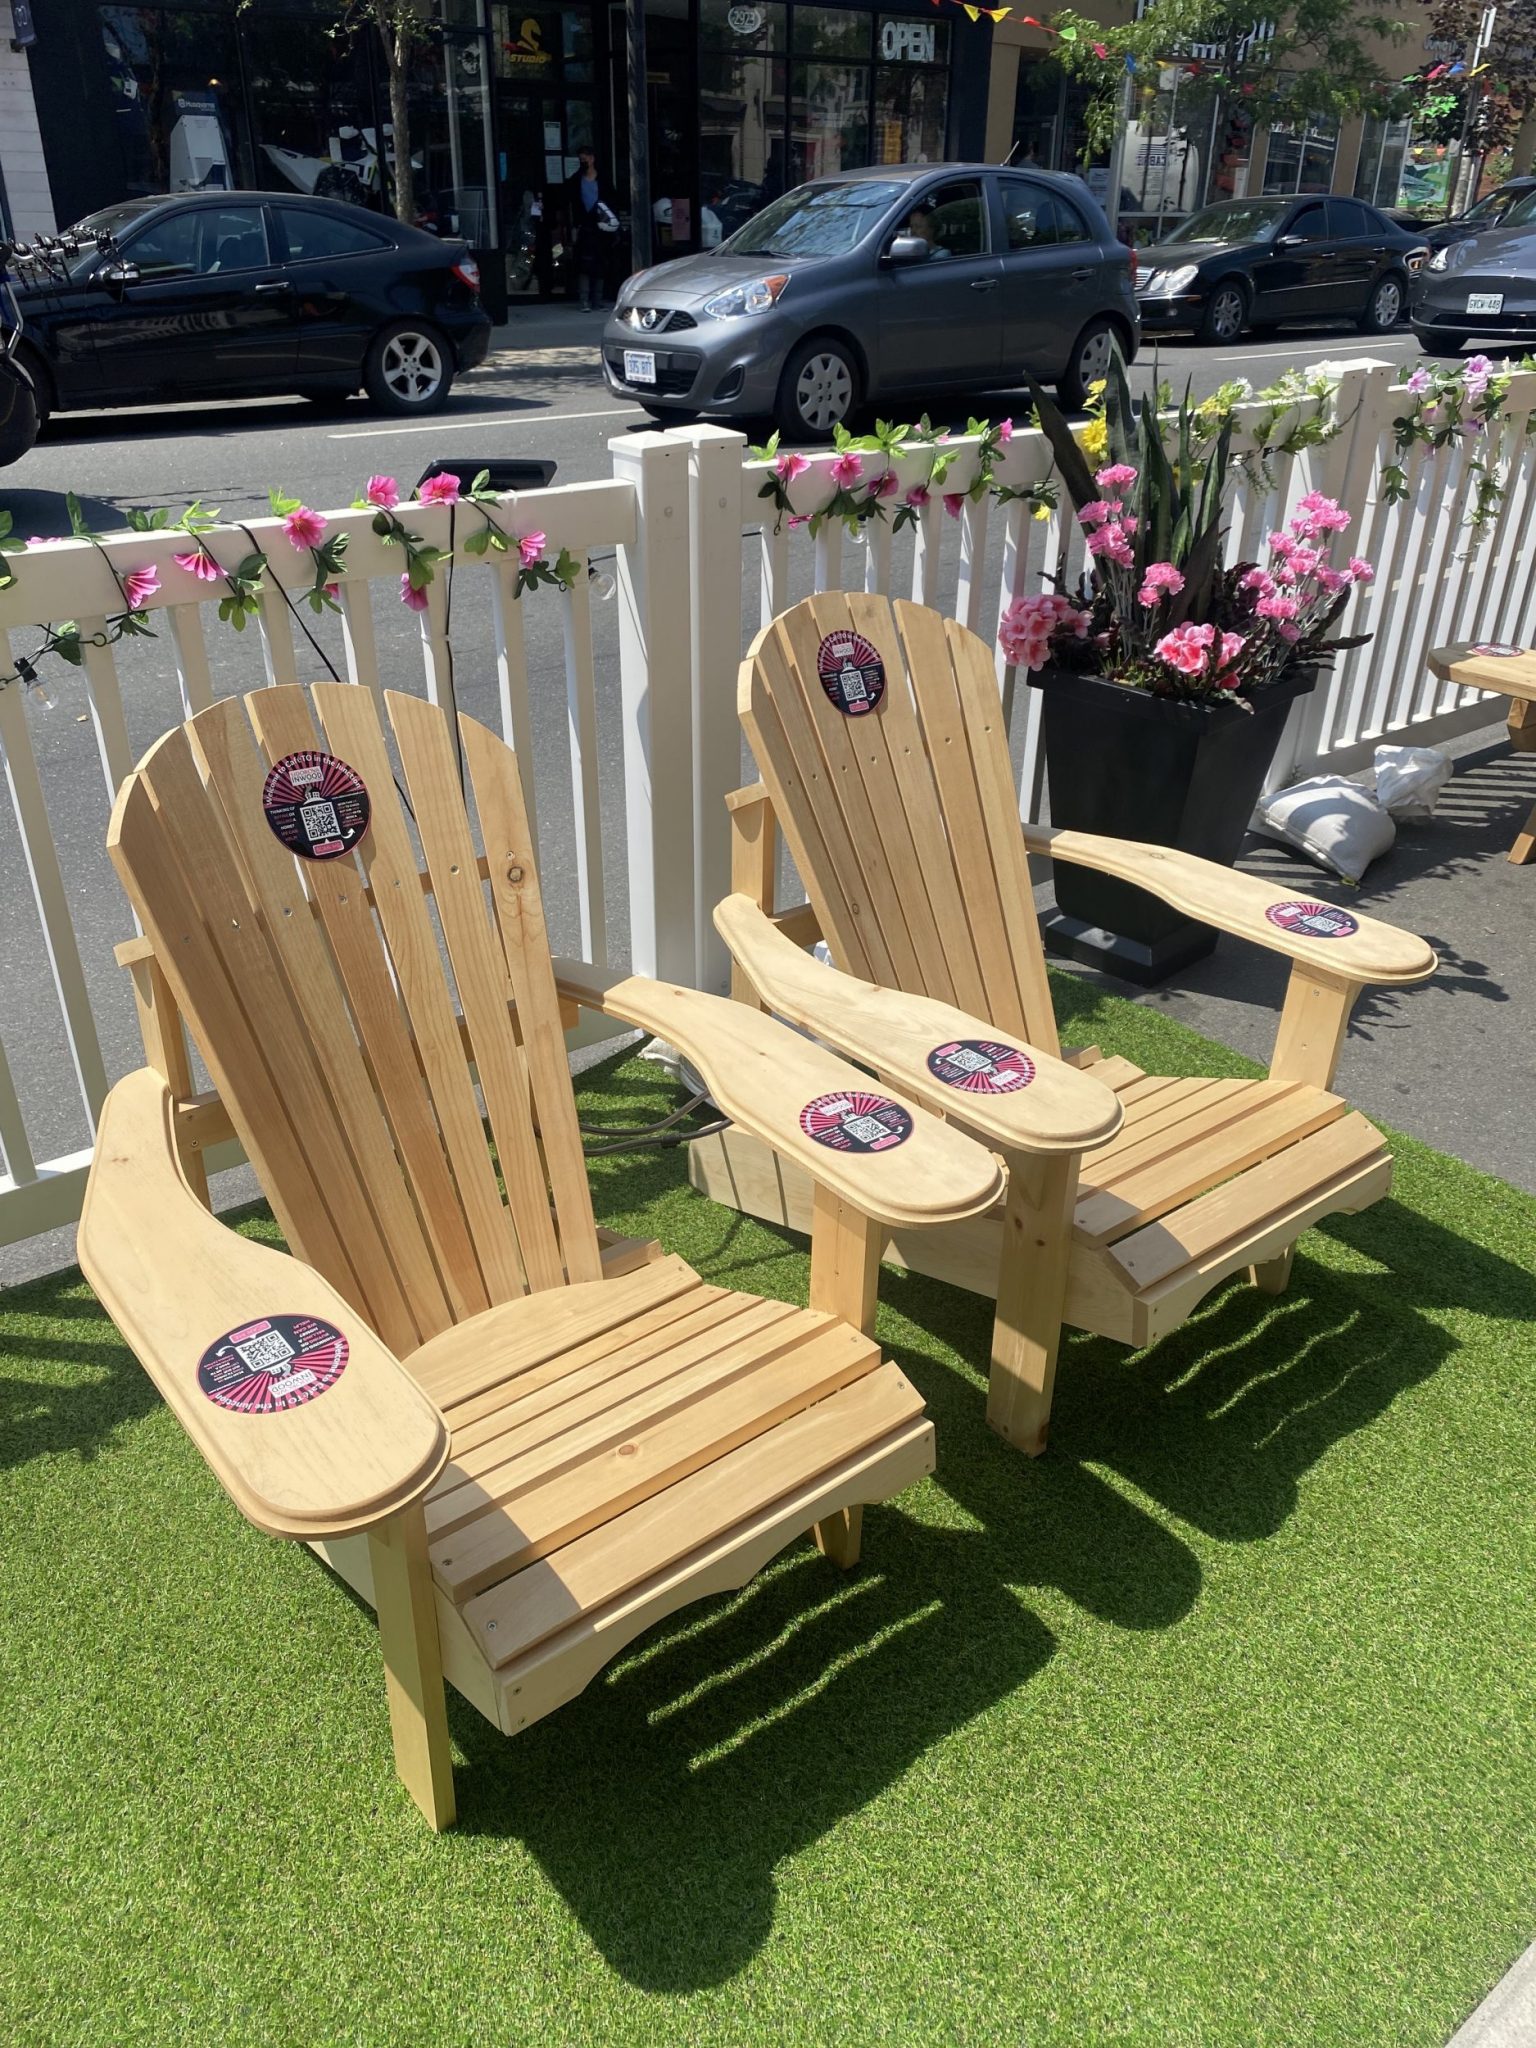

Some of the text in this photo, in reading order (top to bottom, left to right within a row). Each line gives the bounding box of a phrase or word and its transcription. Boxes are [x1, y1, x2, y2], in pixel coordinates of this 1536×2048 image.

[882, 21, 935, 62] OPEN
[509, 53, 547, 64] STUDIO
[266, 774, 280, 805] Welcome
[323, 757, 335, 766] the
[336, 763, 361, 788] Junction
[292, 772, 322, 783] INWOOD
[329, 1342, 345, 1373] Welcome
[270, 1371, 312, 1393] INWOOD
[215, 1394, 253, 1410] Junction
